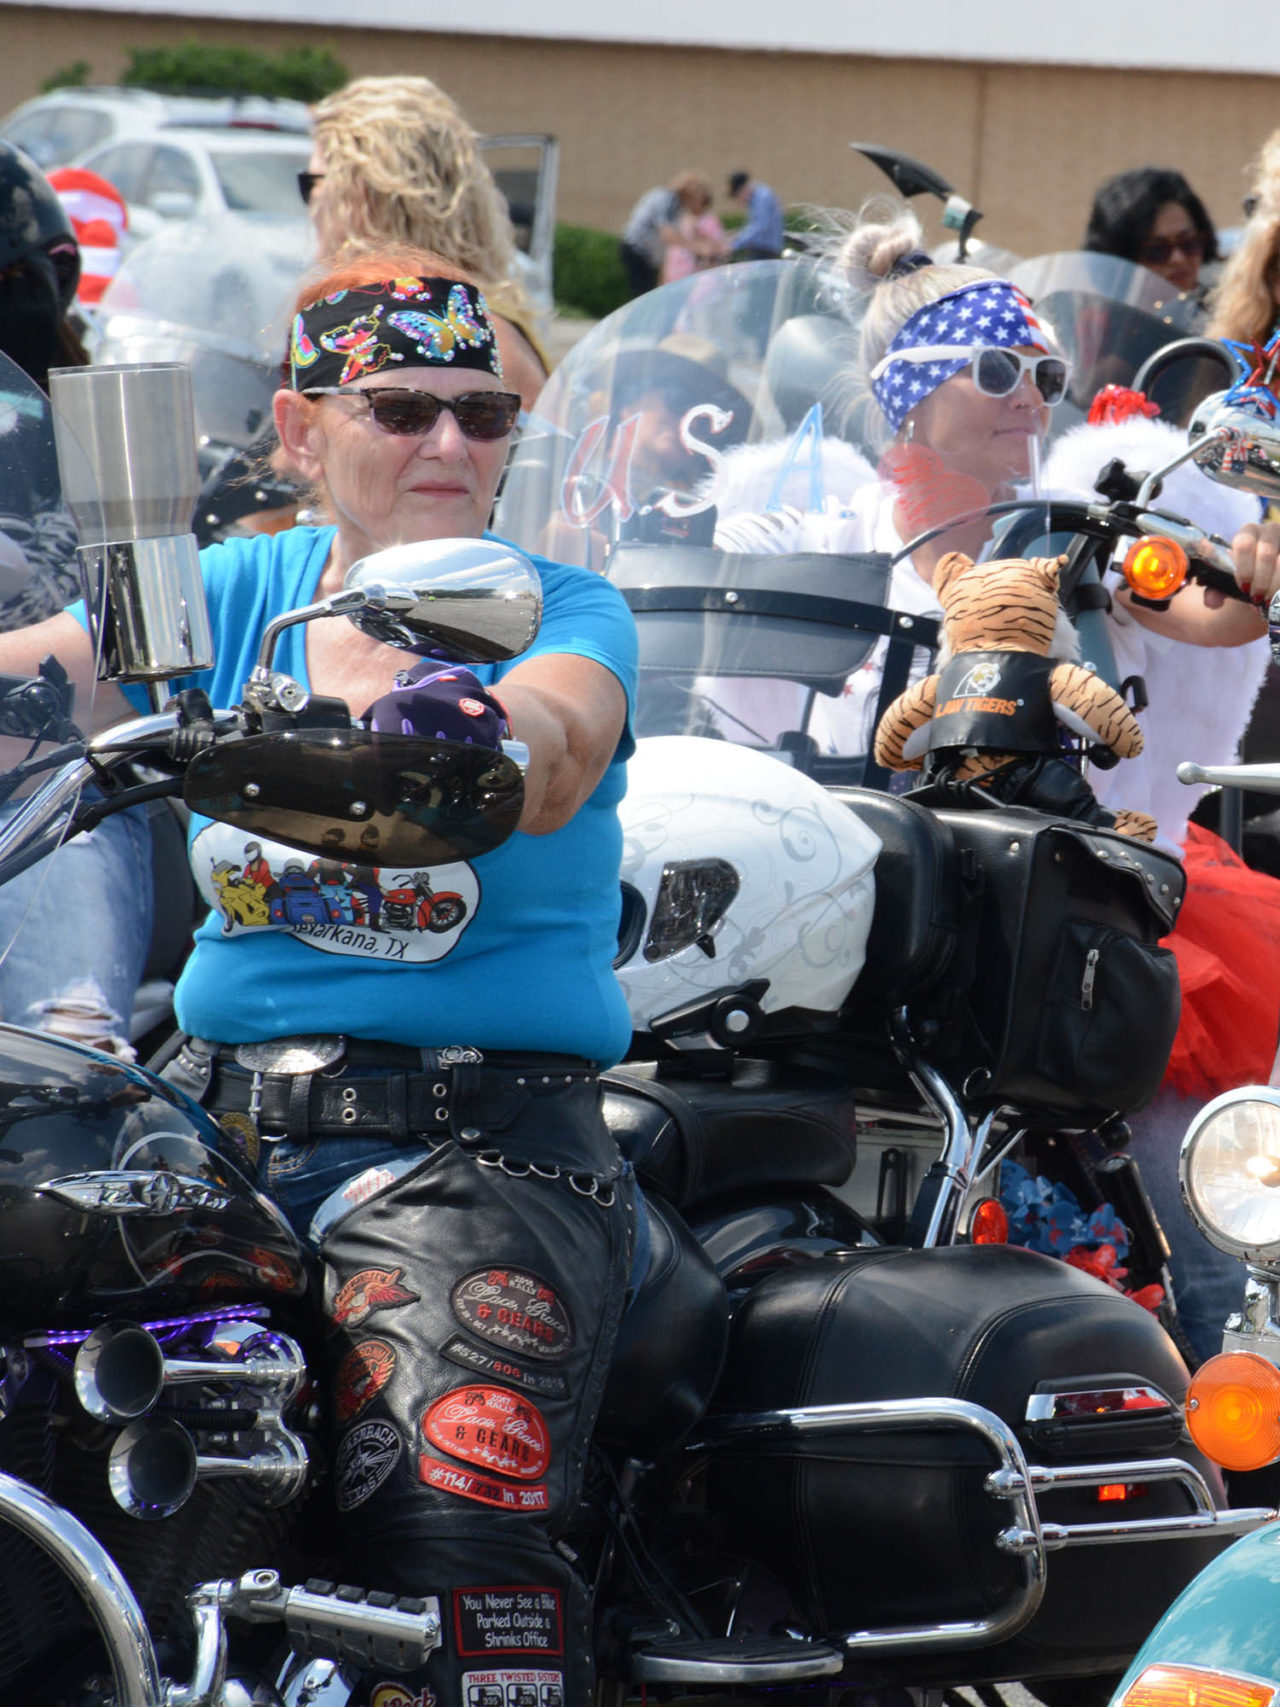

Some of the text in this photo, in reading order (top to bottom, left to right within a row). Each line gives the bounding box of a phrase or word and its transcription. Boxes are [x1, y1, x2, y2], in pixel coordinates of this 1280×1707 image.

[936, 698, 1017, 718] LAW TIGERS
[384, 937, 409, 959] TX
[497, 1307, 554, 1344] GEARS
[455, 1424, 468, 1440] &
[476, 1427, 530, 1462] GEARS
[502, 1487, 515, 1503] in
[519, 1491, 545, 1506] 2017
[462, 1595, 482, 1610] You
[484, 1593, 513, 1610] Never
[516, 1594, 533, 1609] See
[476, 1612, 511, 1629] Parked
[512, 1612, 544, 1629] Outside
[484, 1631, 549, 1648] Shrinks Office
[467, 1673, 498, 1684] THREE
[500, 1672, 536, 1683] TWISTED
